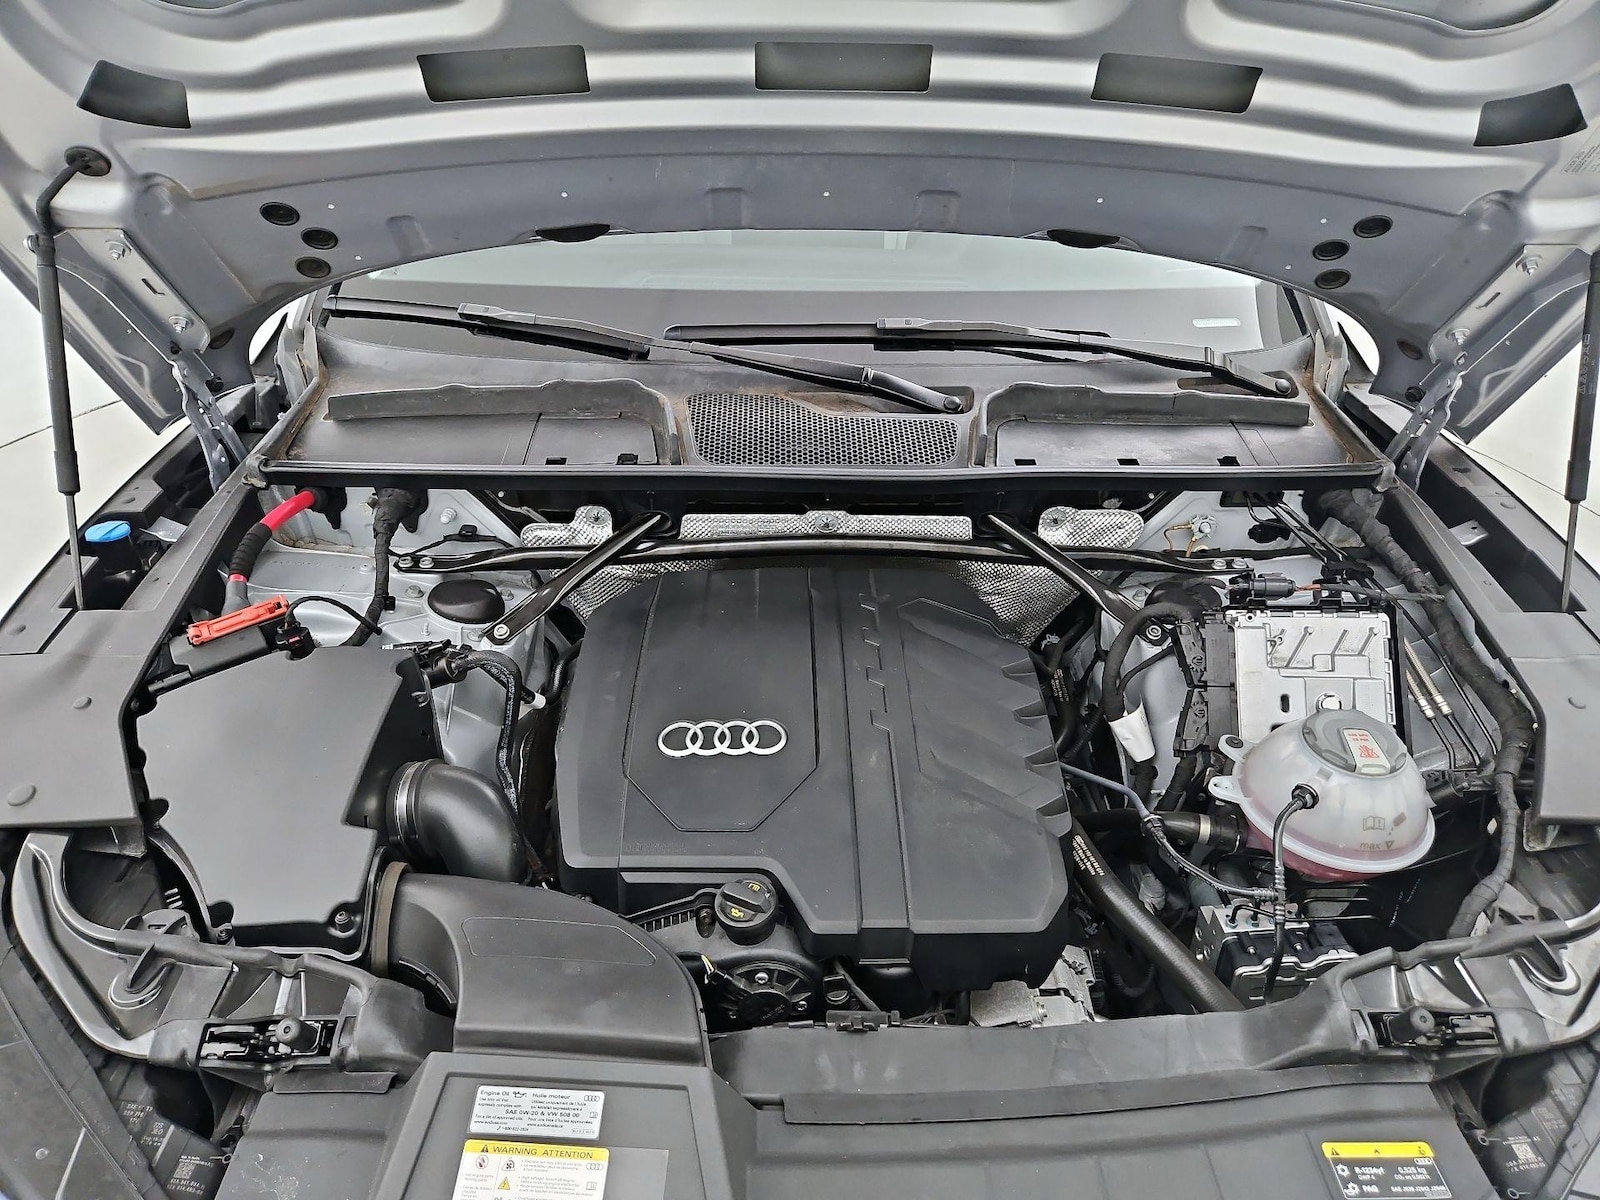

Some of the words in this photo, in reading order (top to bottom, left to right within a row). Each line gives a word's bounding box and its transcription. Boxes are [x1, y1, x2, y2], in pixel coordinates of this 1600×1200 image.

[493, 1146, 537, 1155] WARNING
[543, 1149, 594, 1158] ATTENTION
[1354, 1166, 1384, 1175] R-1234yf
[1417, 1167, 1428, 1175] kg
